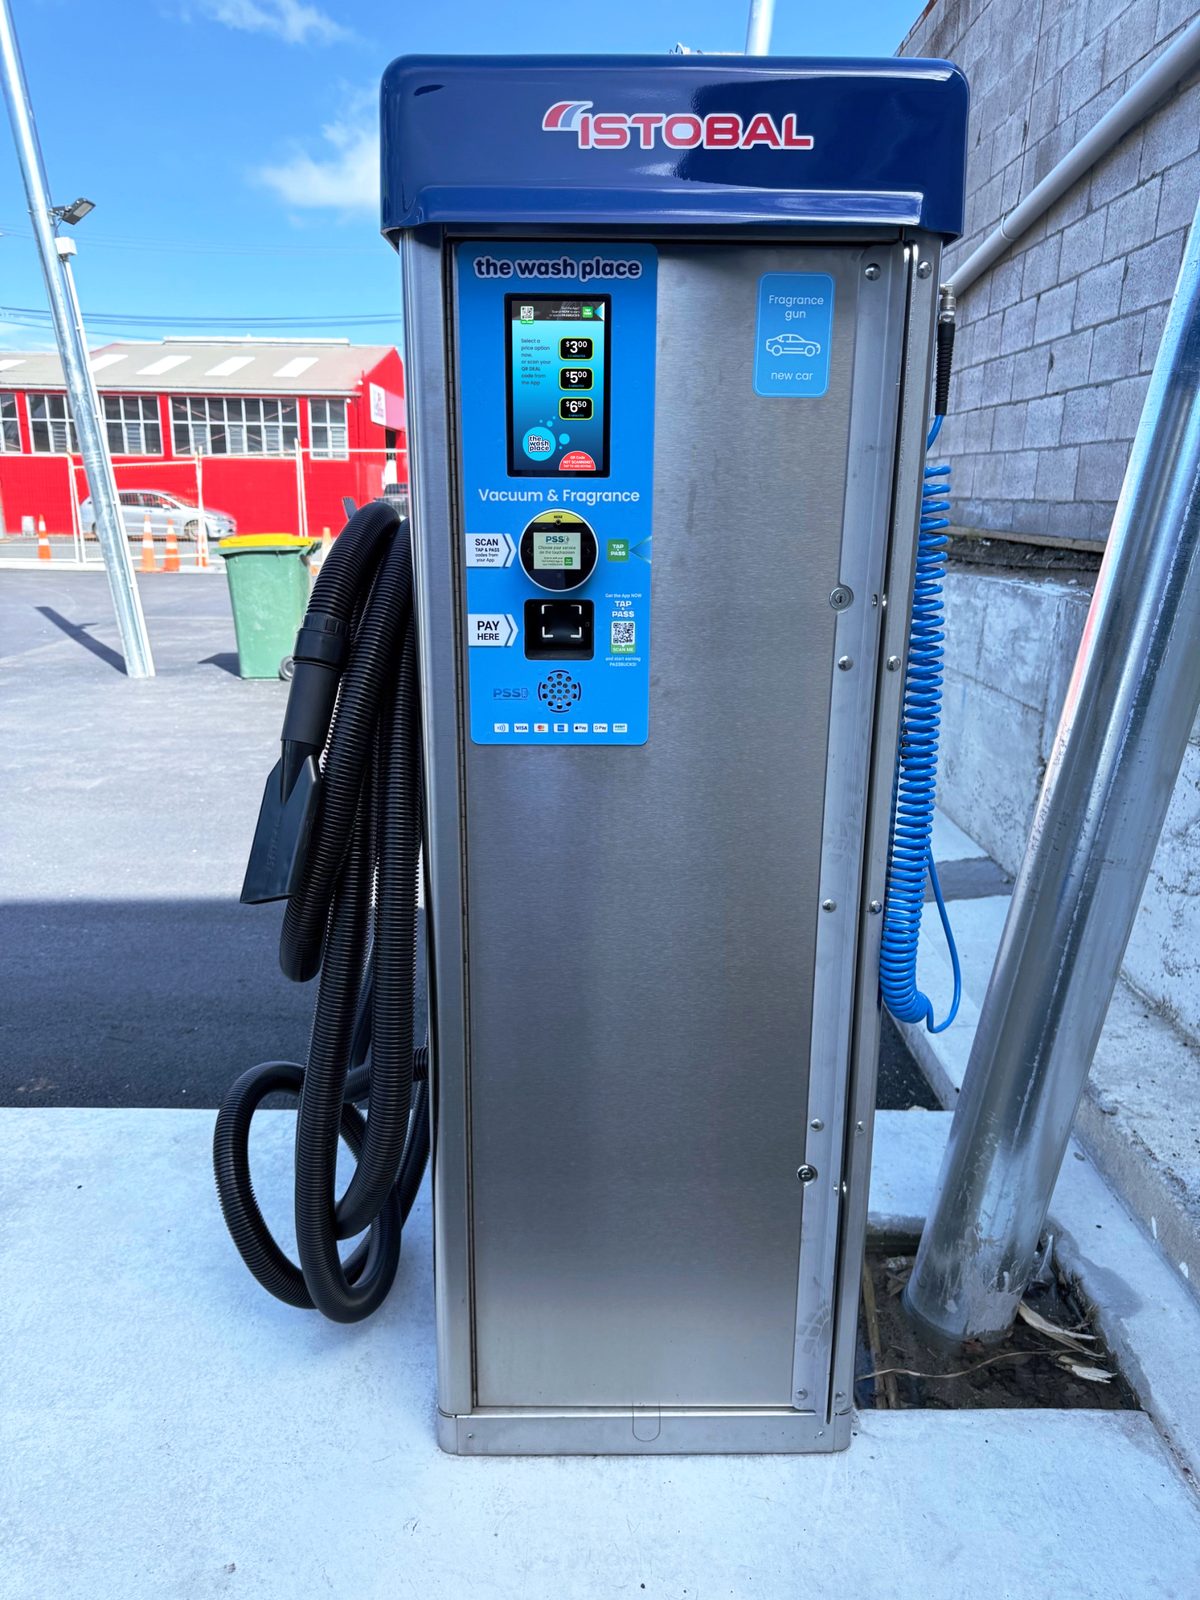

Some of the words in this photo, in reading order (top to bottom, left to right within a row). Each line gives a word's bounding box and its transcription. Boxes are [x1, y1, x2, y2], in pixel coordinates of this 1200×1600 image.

[578, 115, 813, 149] ISTOBAL
[475, 257, 512, 277] the
[516, 257, 576, 277] wash
[580, 257, 641, 280] place
[768, 294, 824, 308] Fragrance
[785, 310, 806, 321] gun
[770, 372, 793, 381] new
[795, 372, 814, 381] car
[478, 489, 543, 502] Vacuum
[547, 489, 559, 502] &
[562, 489, 641, 506] Fragrance
[475, 538, 499, 546] SCAN
[612, 610, 635, 618] PASS
[477, 620, 500, 631] PAY
[477, 632, 500, 641] HERE
